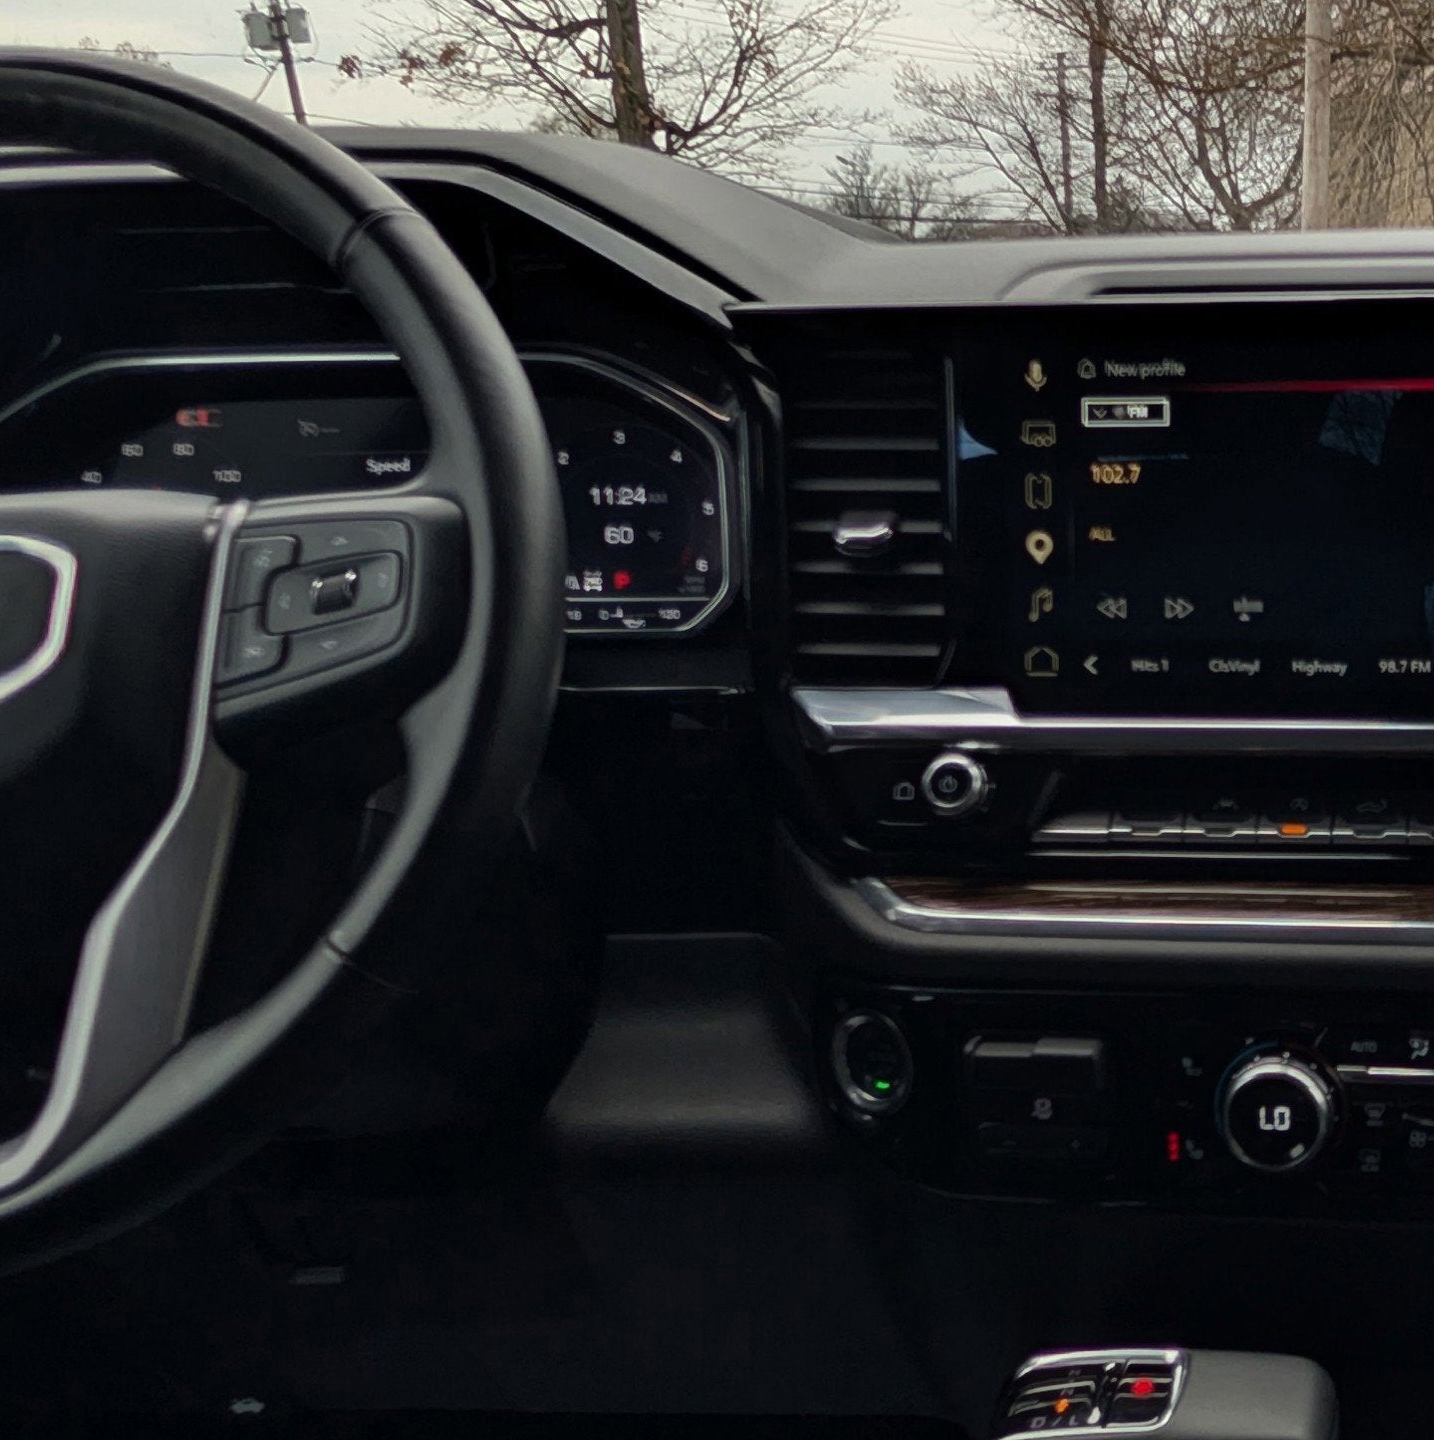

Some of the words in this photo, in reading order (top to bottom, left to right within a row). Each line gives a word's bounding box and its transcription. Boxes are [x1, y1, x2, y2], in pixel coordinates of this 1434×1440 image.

[1104, 359, 1138, 377] New
[1139, 358, 1186, 380] profile
[365, 457, 412, 475] Speed
[1090, 463, 1141, 484] 102.7
[603, 523, 635, 544] 60
[1292, 658, 1347, 677] Highway
[1379, 658, 1407, 674] 98.7
[1410, 658, 1432, 674] FM
